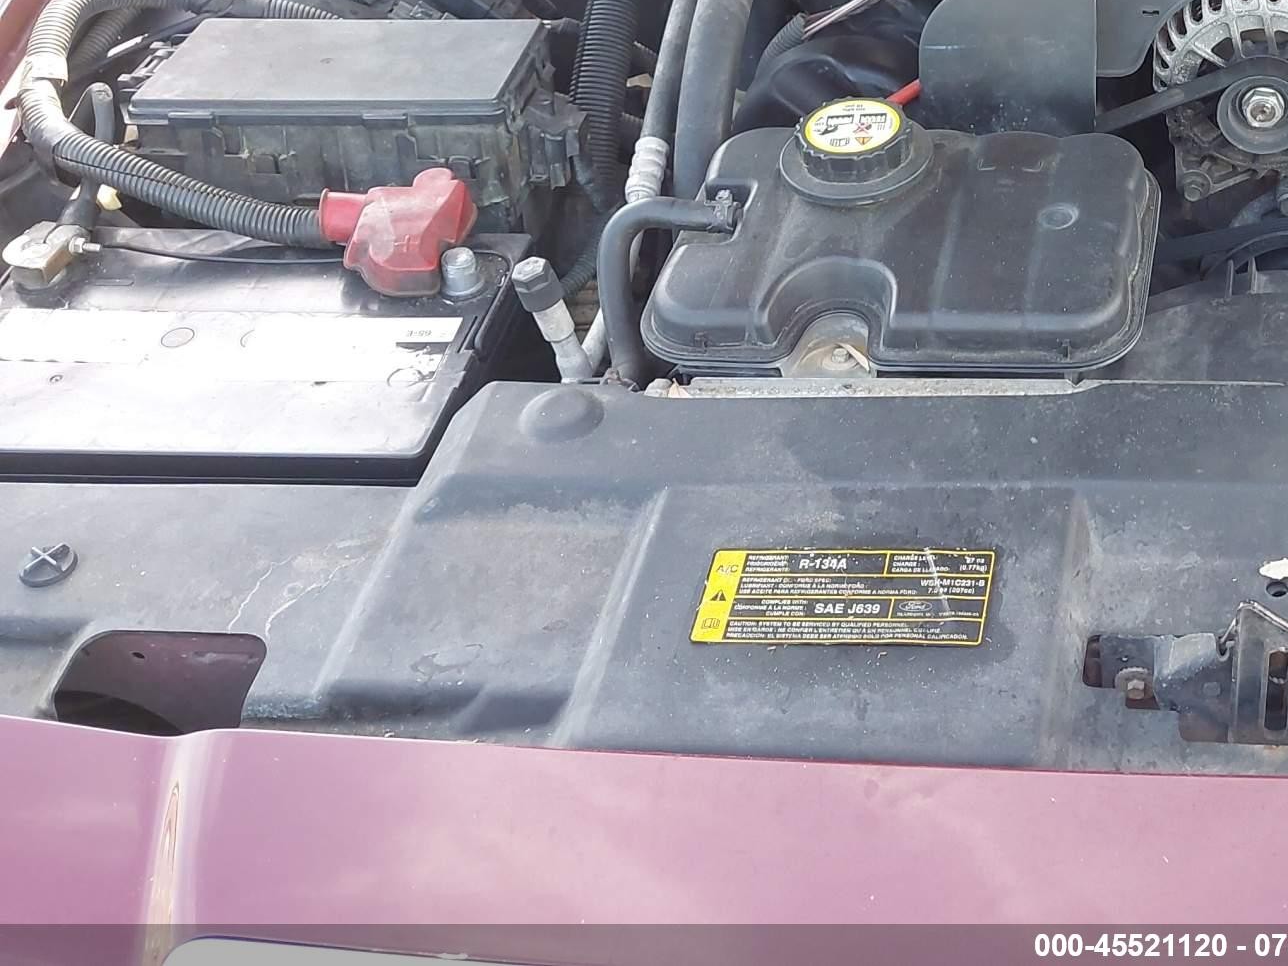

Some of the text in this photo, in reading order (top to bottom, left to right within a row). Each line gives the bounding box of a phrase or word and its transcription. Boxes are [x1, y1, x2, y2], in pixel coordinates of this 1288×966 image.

[798, 558, 848, 570] R-134A
[815, 603, 881, 614] SAE J639
